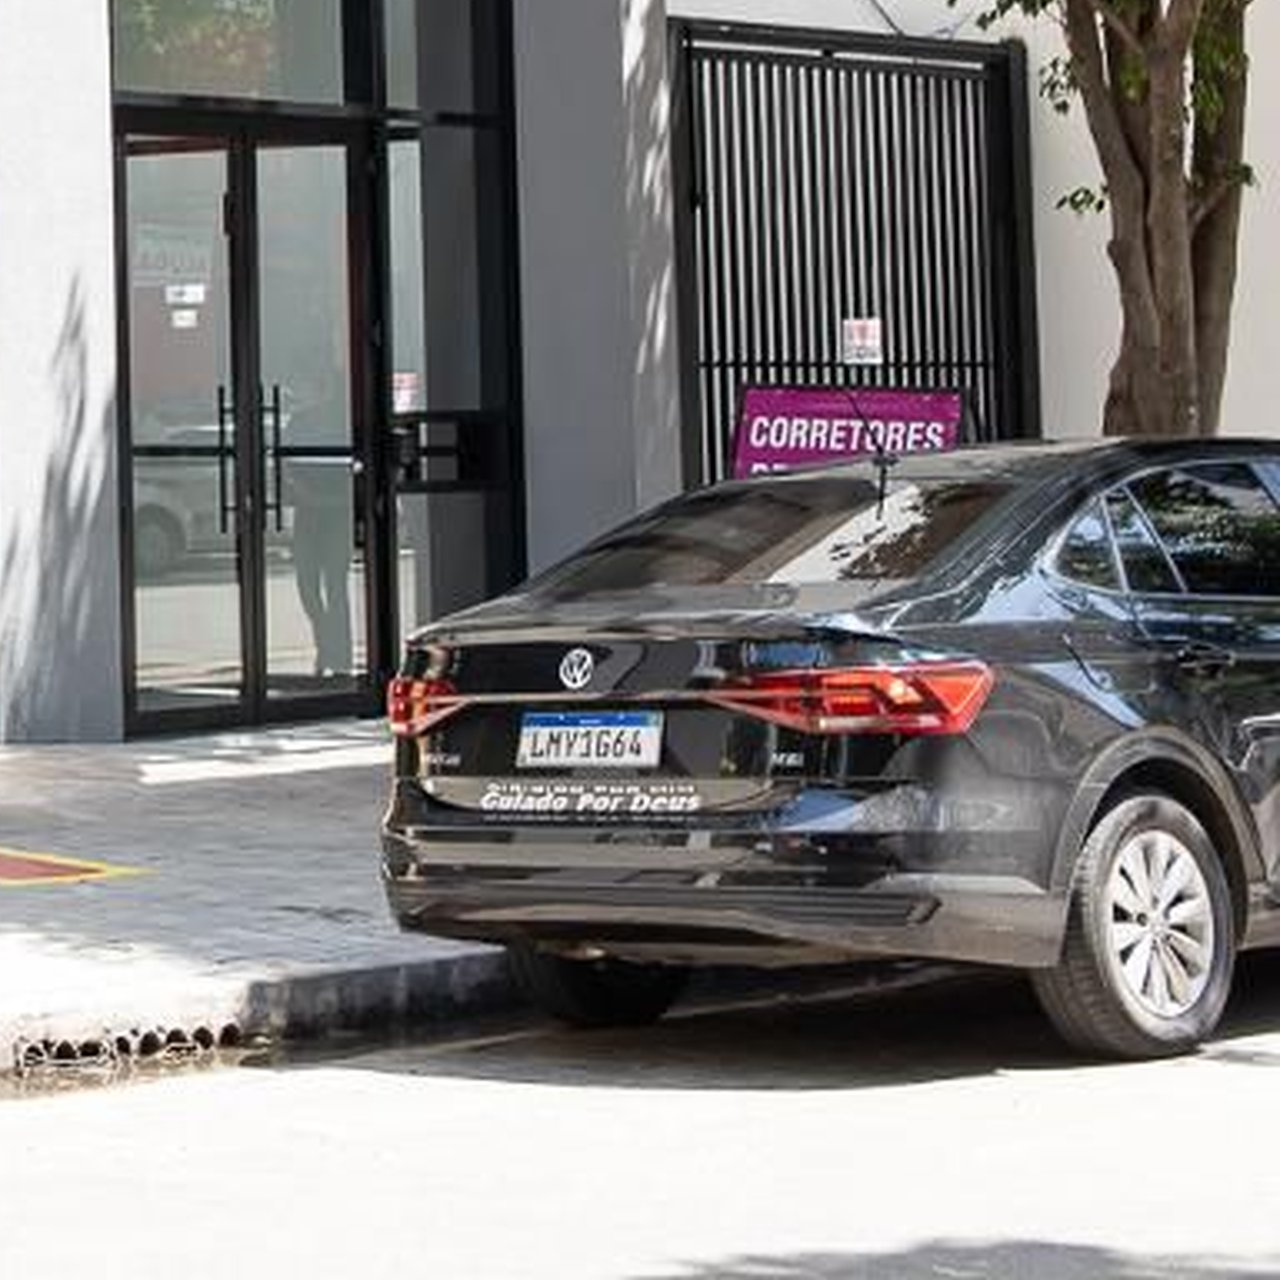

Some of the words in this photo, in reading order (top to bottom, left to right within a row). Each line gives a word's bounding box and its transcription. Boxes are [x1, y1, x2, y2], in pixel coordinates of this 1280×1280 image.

[750, 416, 944, 452] CORRETORES
[576, 793, 624, 812] Por
[630, 793, 700, 812] Deus
